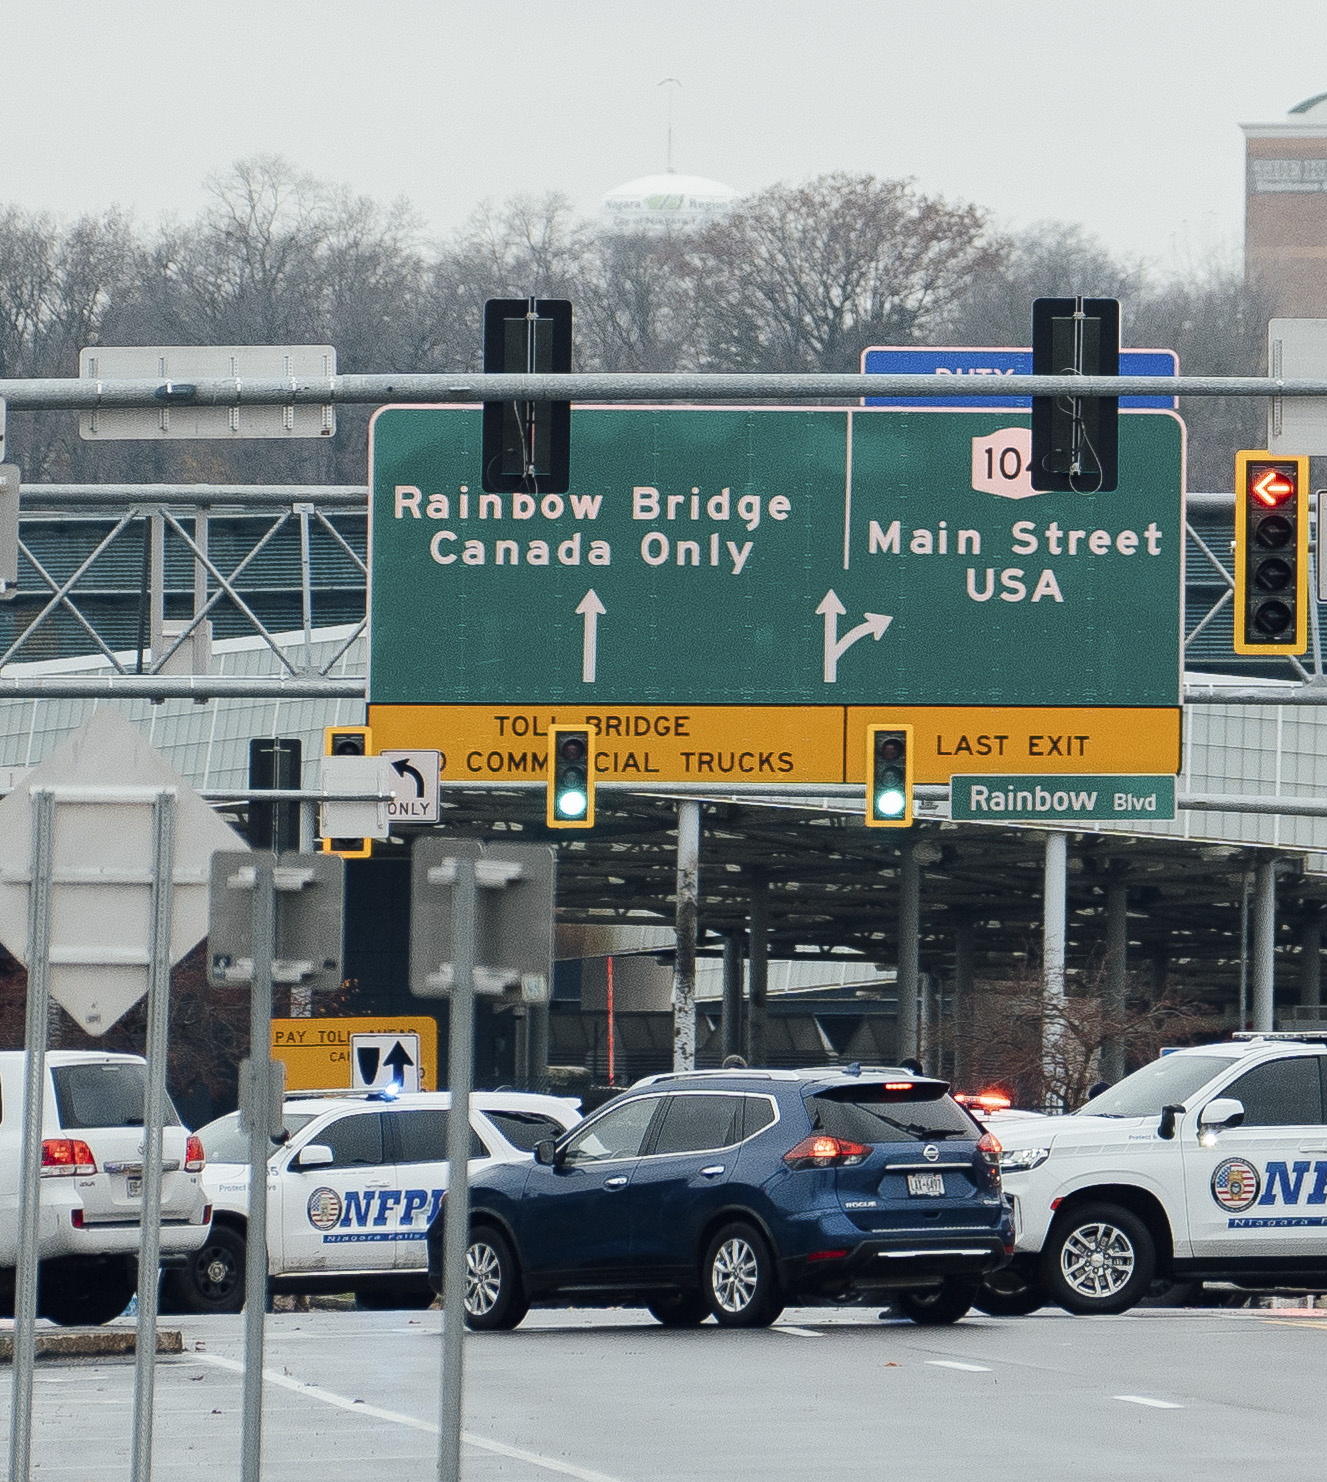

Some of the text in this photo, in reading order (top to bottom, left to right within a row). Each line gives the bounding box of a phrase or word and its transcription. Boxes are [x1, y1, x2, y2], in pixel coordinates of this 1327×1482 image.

[984, 447, 1032, 480] 10
[394, 485, 791, 531] Rainbow Bridge
[868, 520, 1162, 555] Main Street
[430, 530, 754, 575] Canada Only
[966, 567, 1064, 602] USA
[585, 715, 690, 736] BRIDGE
[937, 735, 1090, 756] LAST EXIT
[466, 751, 659, 773] COMMCIAL
[680, 752, 794, 772] TRUCKS
[388, 802, 430, 815] ONLY
[970, 785, 1156, 811] Rainbow Blvd
[275, 1031, 307, 1043] PAY
[219, 1184, 246, 1192] Protect
[1234, 1218, 1308, 1227] Niagara
